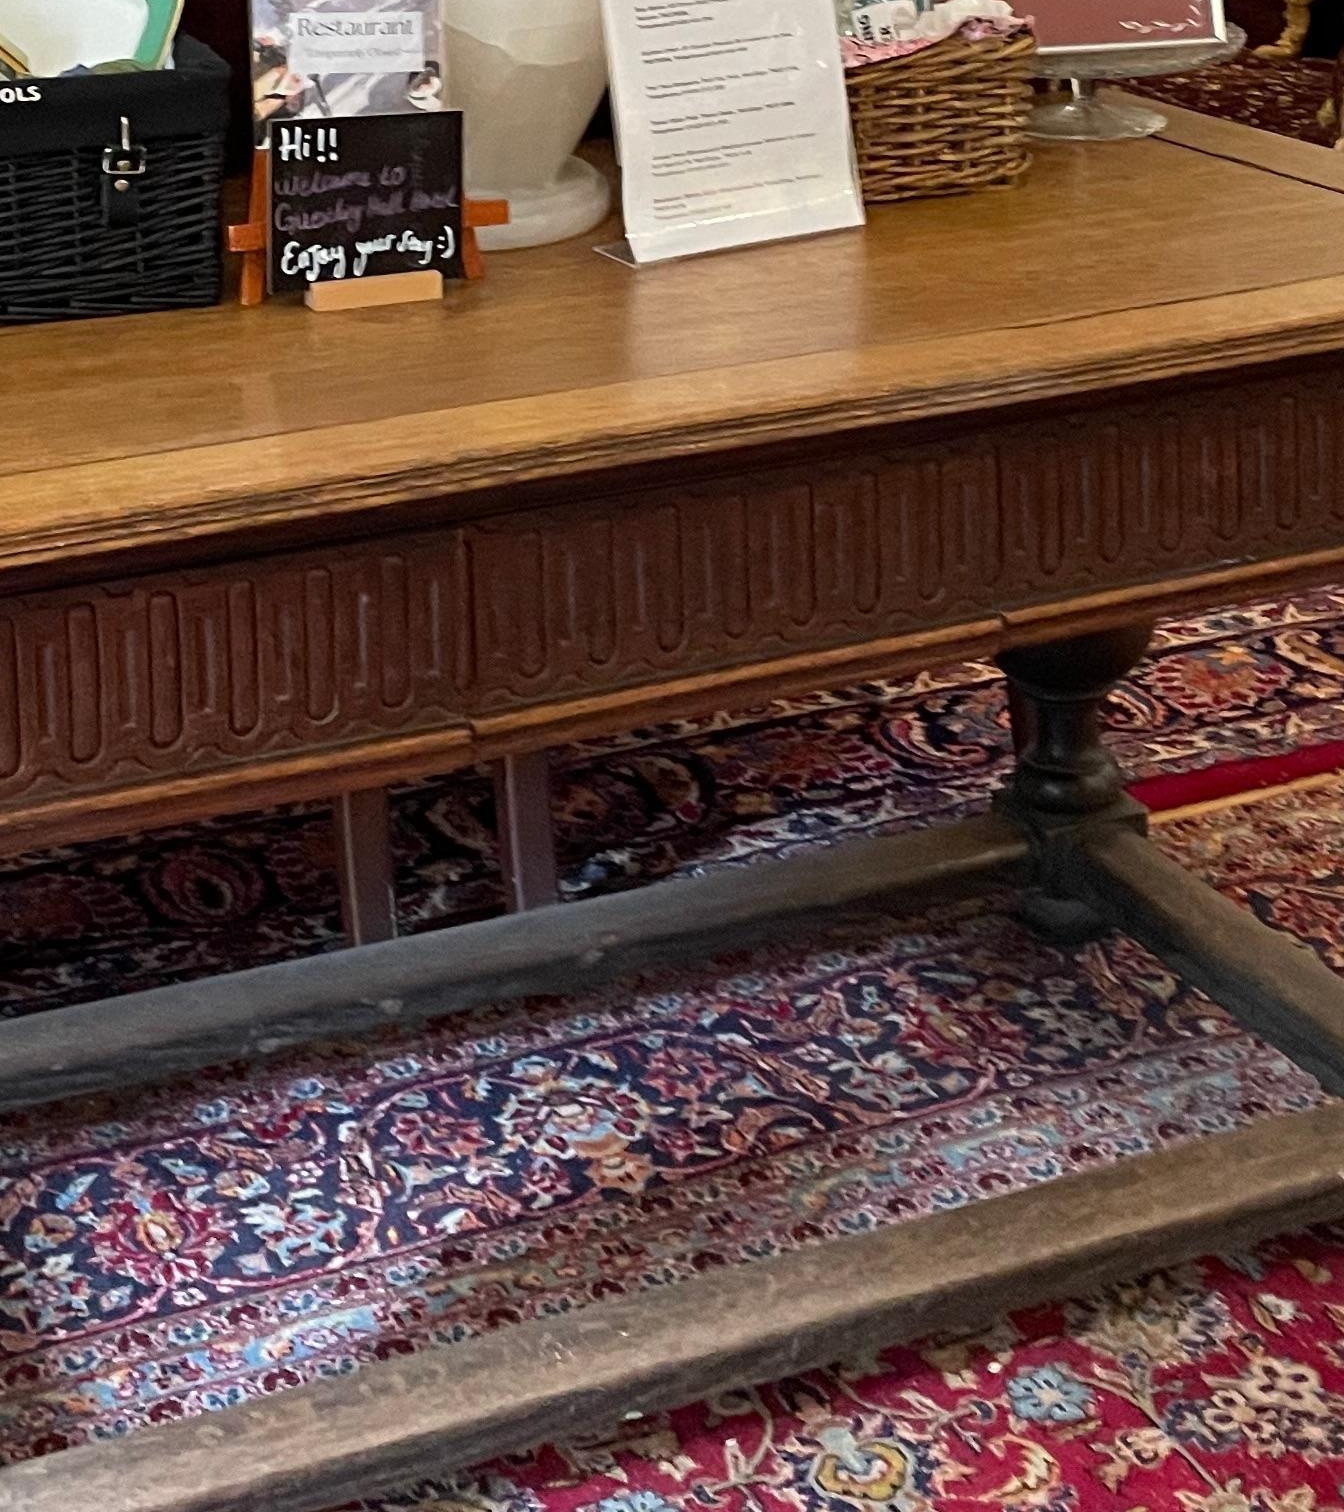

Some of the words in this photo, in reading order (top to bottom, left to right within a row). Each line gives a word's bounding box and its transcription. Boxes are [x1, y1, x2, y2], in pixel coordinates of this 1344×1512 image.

[297, 17, 414, 37] Restaurant
[281, 241, 347, 282] Enjoy
[353, 234, 397, 277] your
